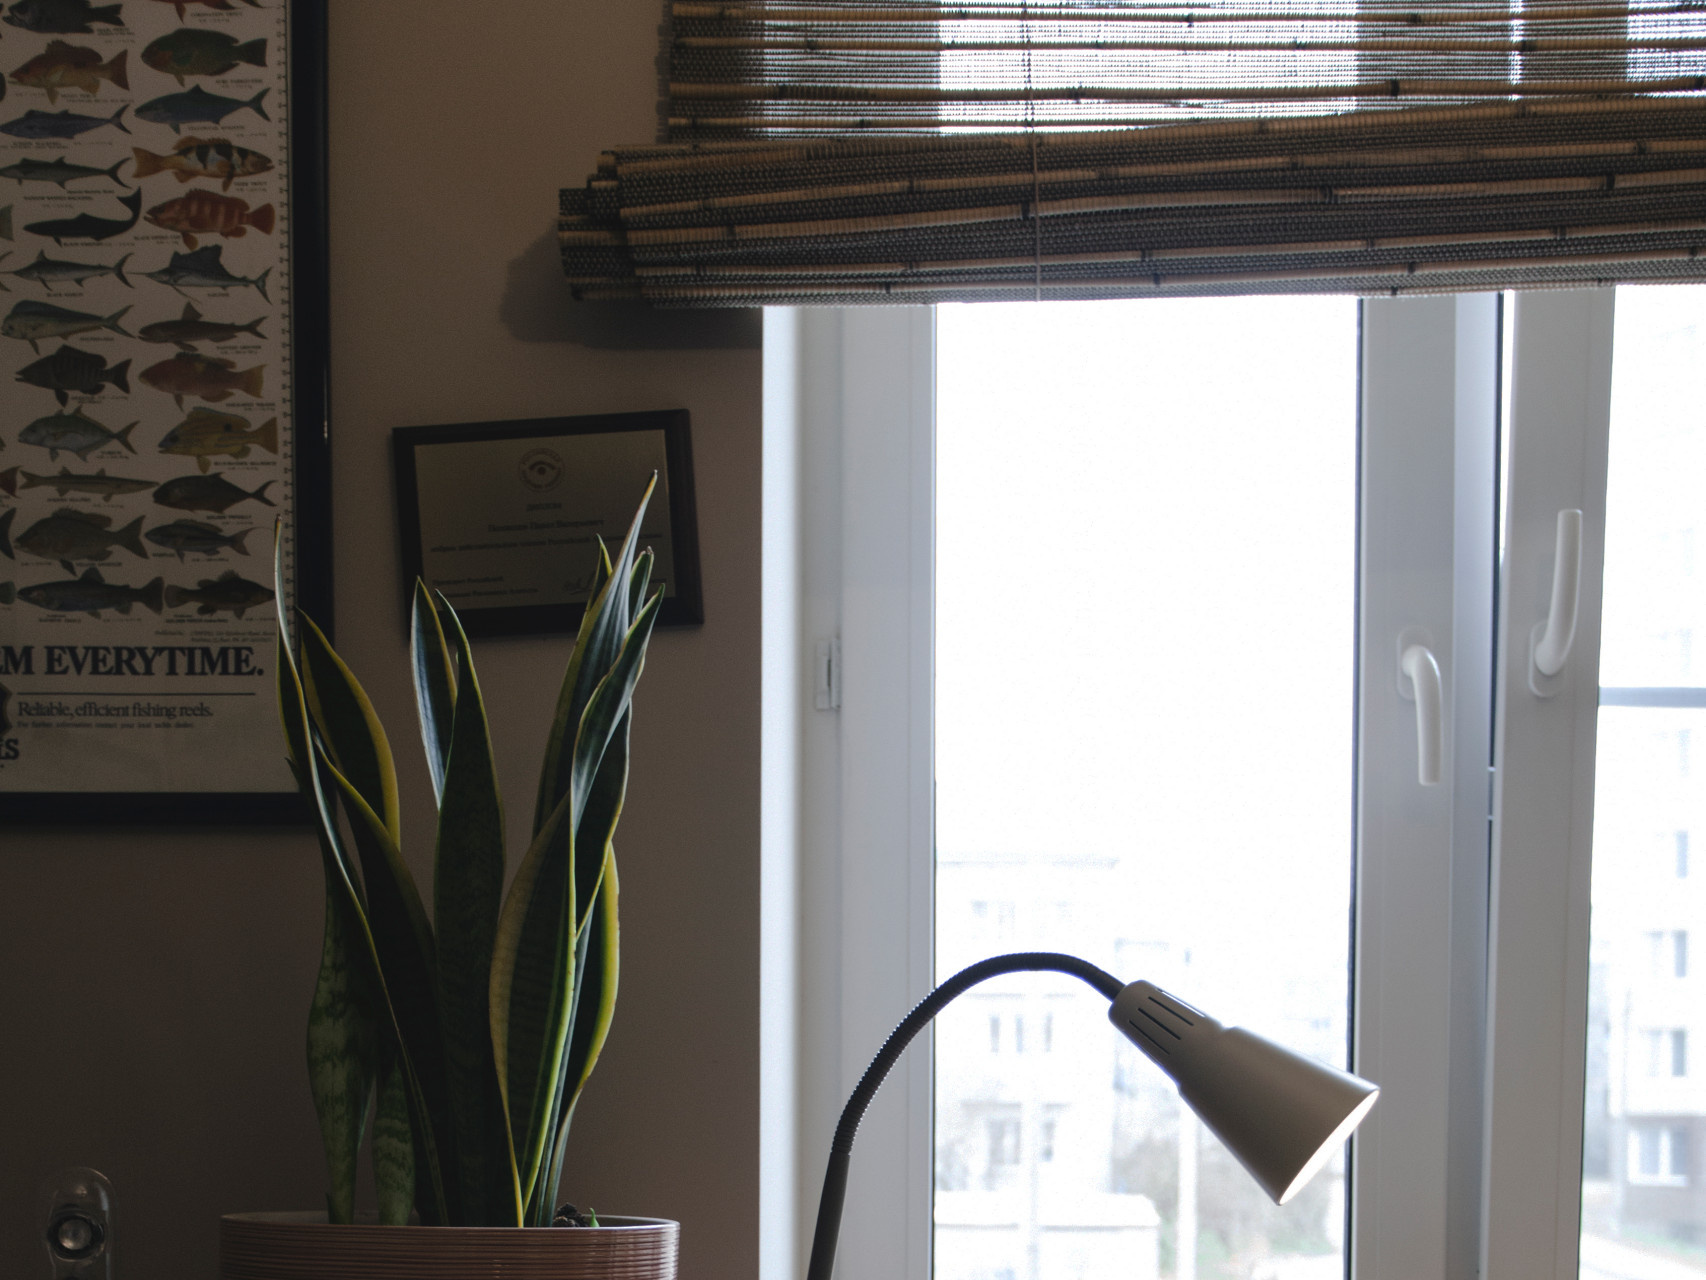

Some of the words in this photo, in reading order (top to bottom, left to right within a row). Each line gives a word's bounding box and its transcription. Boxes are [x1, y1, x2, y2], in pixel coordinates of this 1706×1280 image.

[0, 646, 35, 675] M
[44, 646, 264, 676] EVERYTIME.
[18, 702, 74, 719] Reliable,
[75, 701, 129, 717] efficient
[132, 702, 176, 719] fishing
[179, 702, 213, 717] reels.
